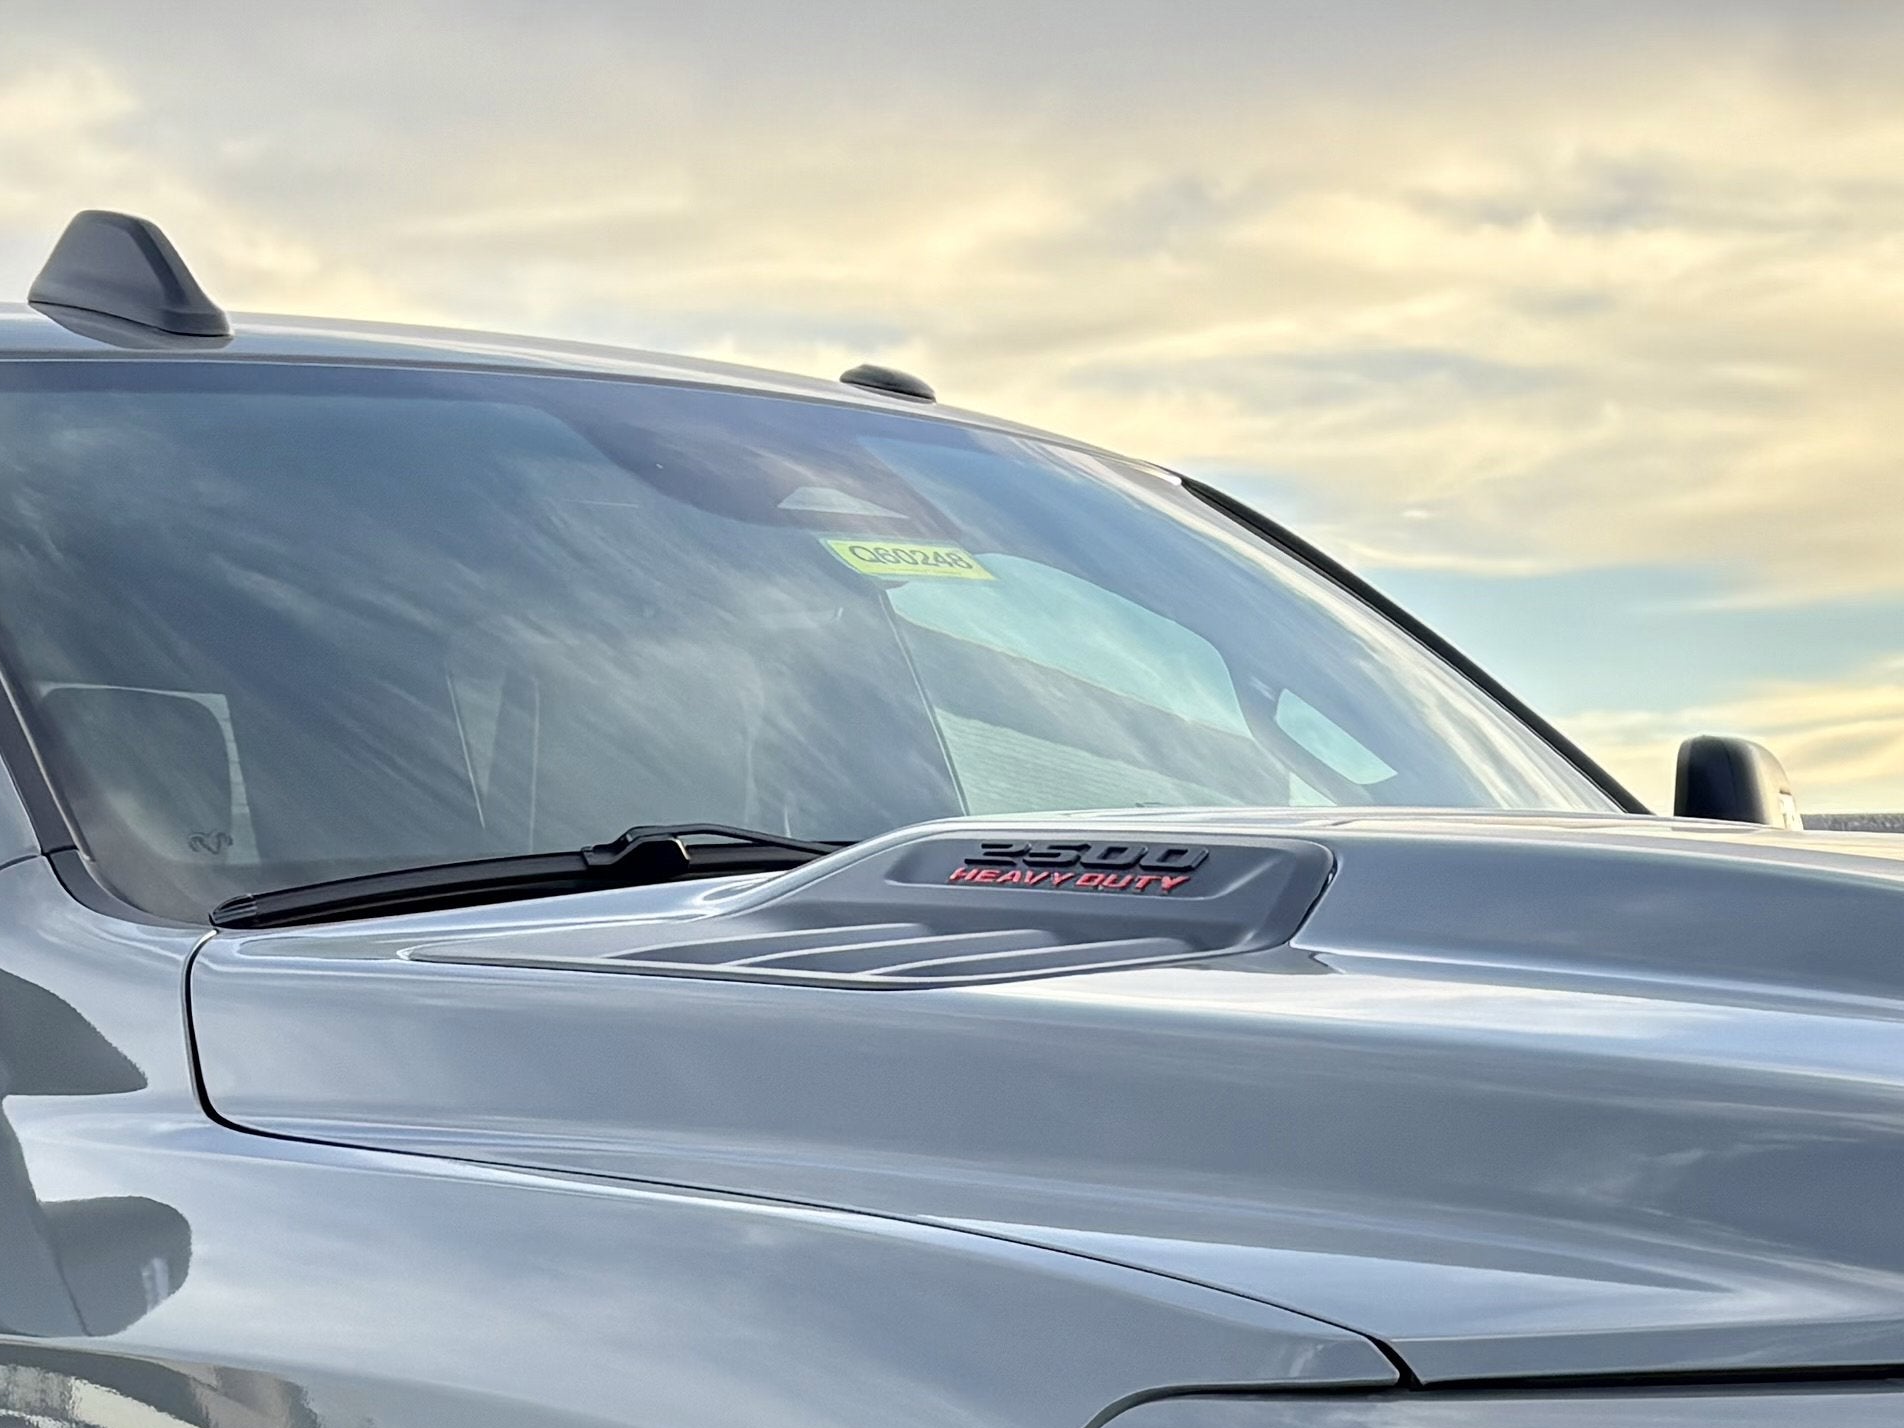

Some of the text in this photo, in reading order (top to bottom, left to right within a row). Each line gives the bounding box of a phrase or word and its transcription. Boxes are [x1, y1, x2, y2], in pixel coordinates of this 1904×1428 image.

[848, 545, 974, 569] Q60248
[964, 842, 1210, 873] 2500
[949, 866, 1190, 895] HEAVY DUTY
